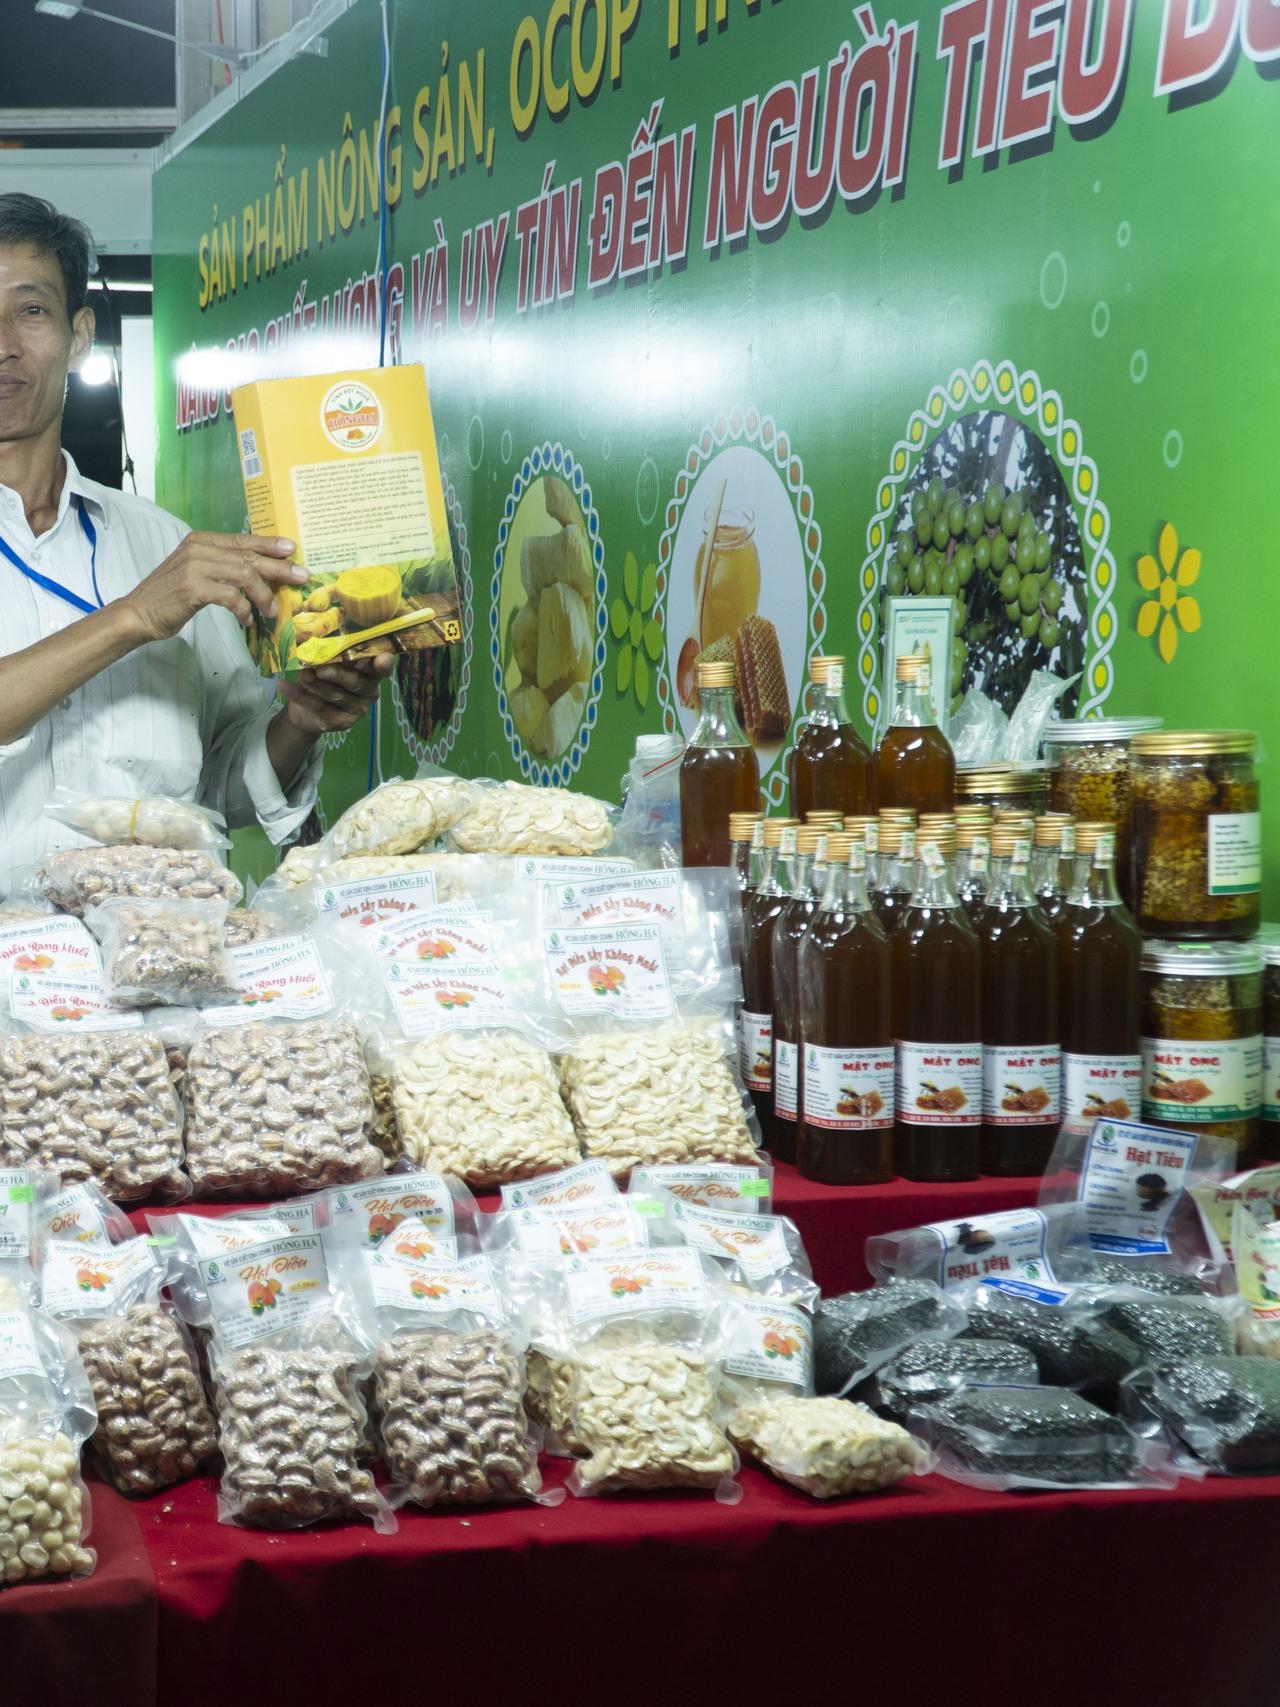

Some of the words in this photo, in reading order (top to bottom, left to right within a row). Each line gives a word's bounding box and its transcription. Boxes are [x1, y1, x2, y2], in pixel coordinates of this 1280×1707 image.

[198, 205, 236, 308] SẢN
[242, 144, 309, 284] PHẨM
[317, 111, 402, 243] NÔNG
[412, 41, 496, 192] SẢN,
[411, 216, 449, 342] VÀ
[458, 211, 510, 329] UY
[516, 160, 582, 315] TÍN
[587, 97, 696, 289] ĐẾN
[702, 2, 918, 250] NGƯỜI
[874, 1060, 894, 1071] ONG
[923, 1056, 951, 1068] MẬT
[957, 1057, 981, 1067] ONG
[1007, 1057, 1035, 1069] MẬT
[1040, 1057, 1061, 1067] ONG
[1153, 1053, 1183, 1067] MẬT
[1189, 1056, 1220, 1067] ONG
[1126, 1146, 1152, 1166] Hạt
[1156, 1150, 1185, 1169] Tiêu
[10, 1175, 24, 1184] HÀ
[271, 1255, 308, 1274] Điều
